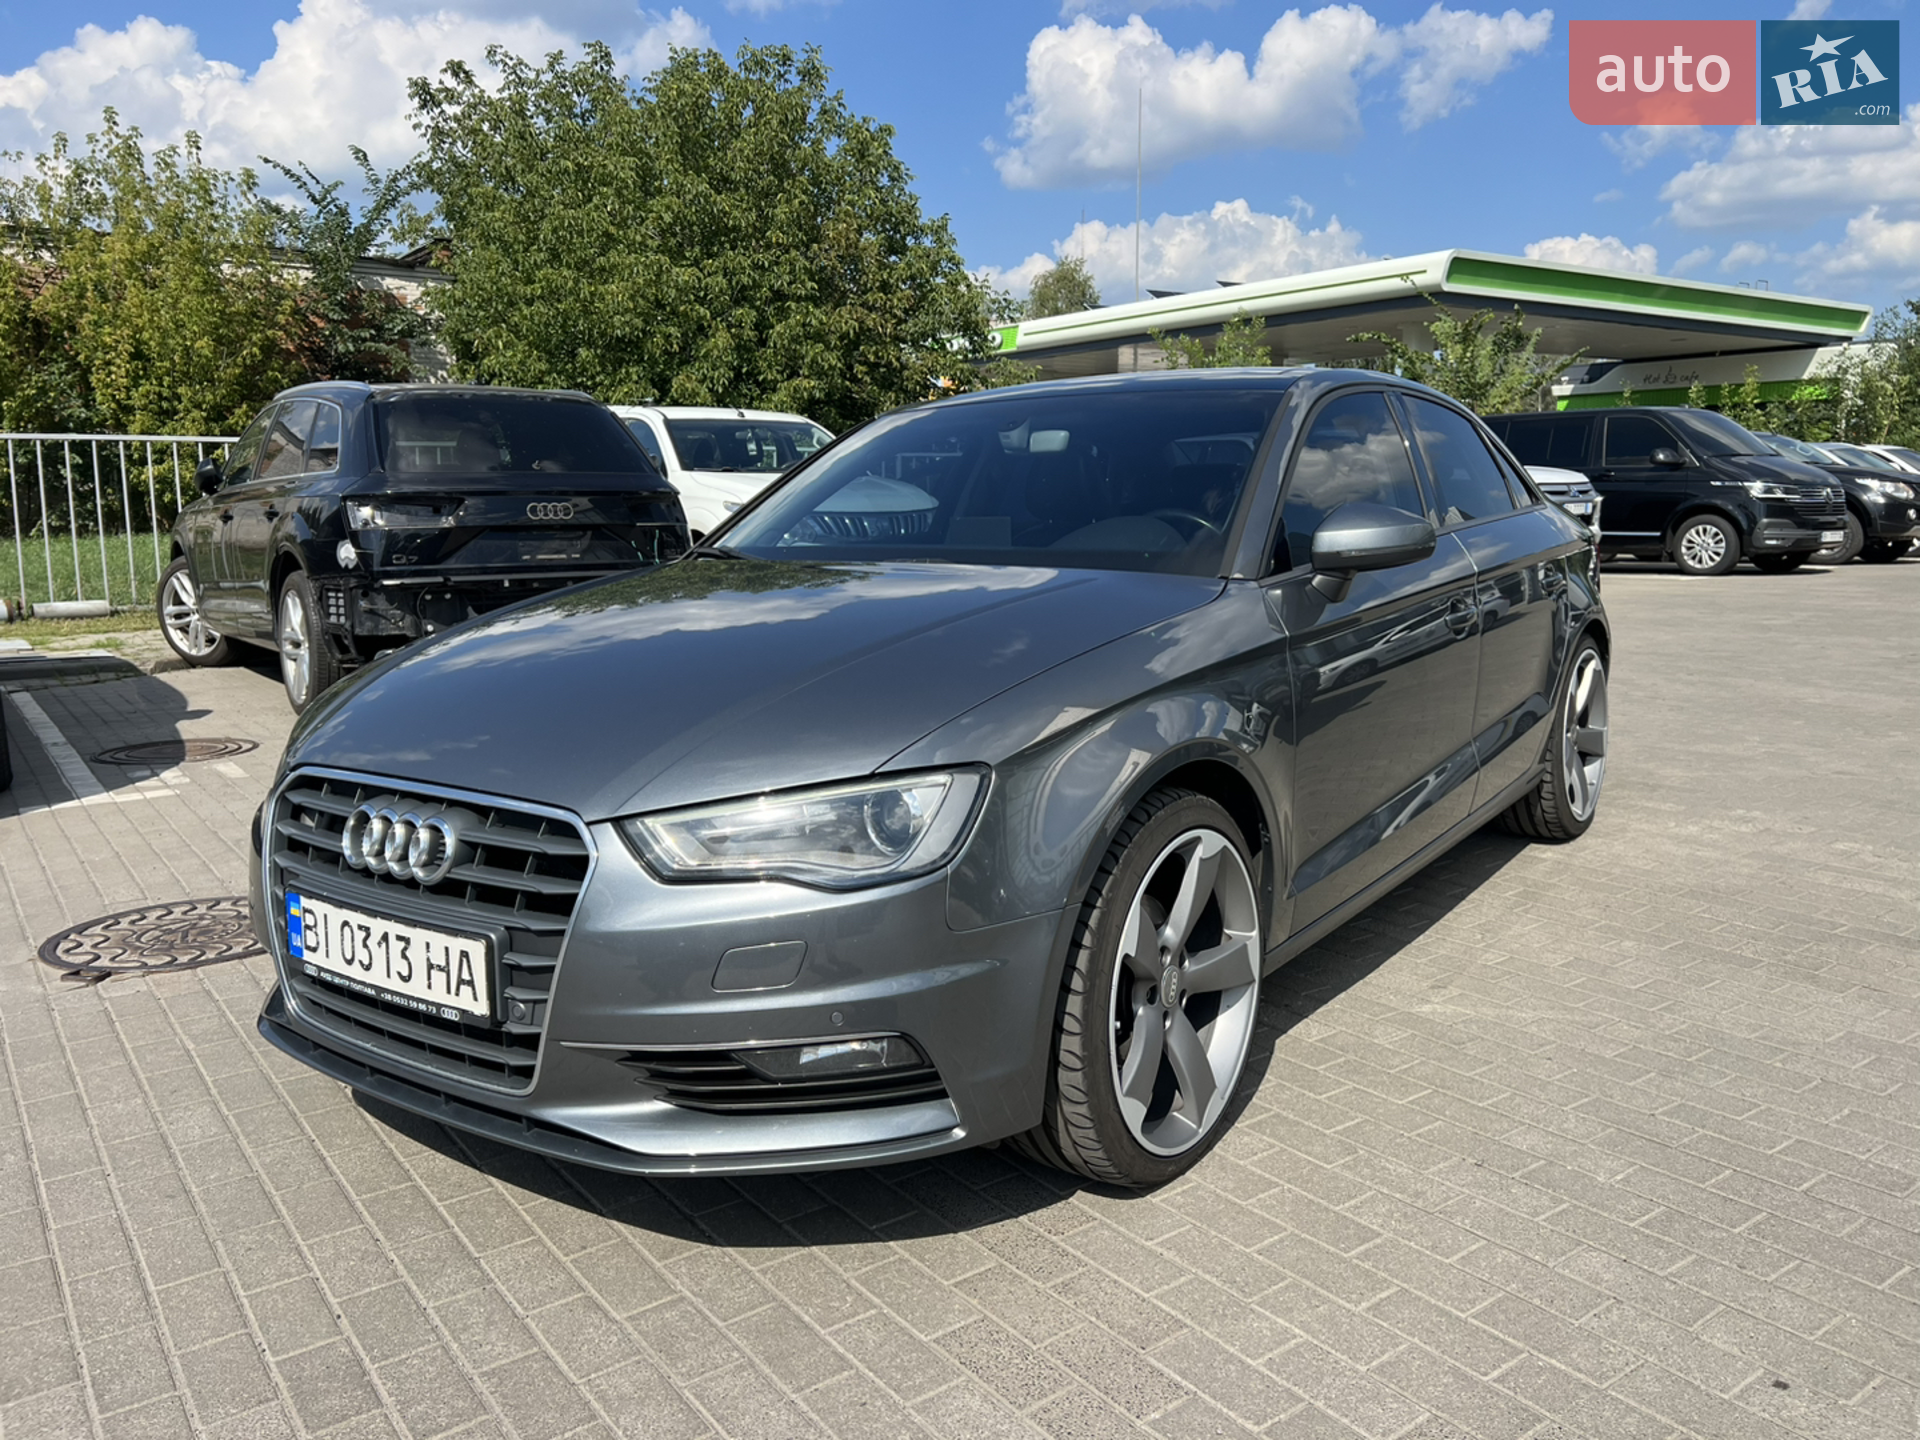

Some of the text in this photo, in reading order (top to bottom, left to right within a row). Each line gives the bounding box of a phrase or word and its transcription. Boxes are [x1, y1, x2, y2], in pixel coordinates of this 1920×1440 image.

[303, 906, 480, 1003] BI 0313 HA
